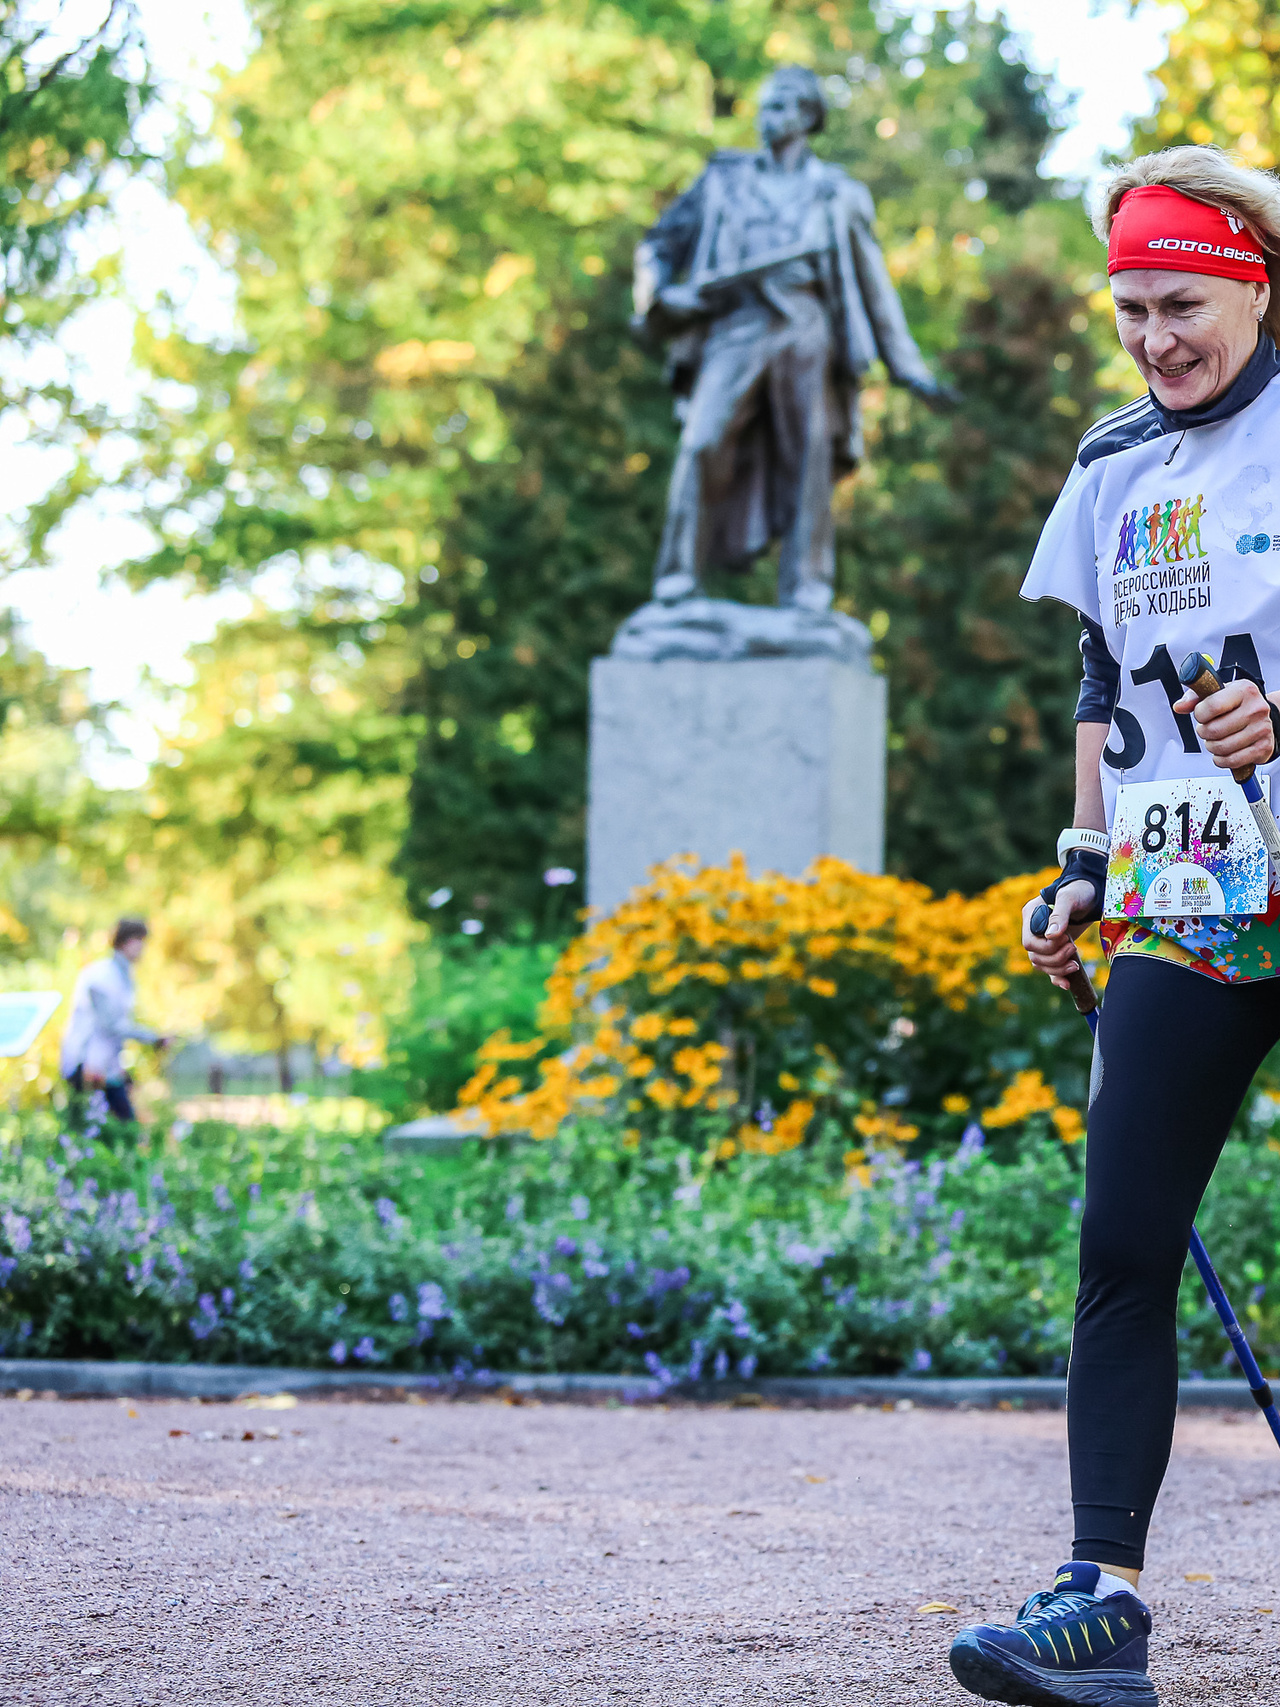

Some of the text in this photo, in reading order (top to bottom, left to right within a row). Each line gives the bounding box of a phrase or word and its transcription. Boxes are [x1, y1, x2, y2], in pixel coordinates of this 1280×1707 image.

[1113, 561, 1210, 600] ВСЕРОССИЙСКИЙ
[1113, 586, 1211, 629] ДЕНЬ ХОДЬБЫ
[1142, 800, 1231, 853] 814
